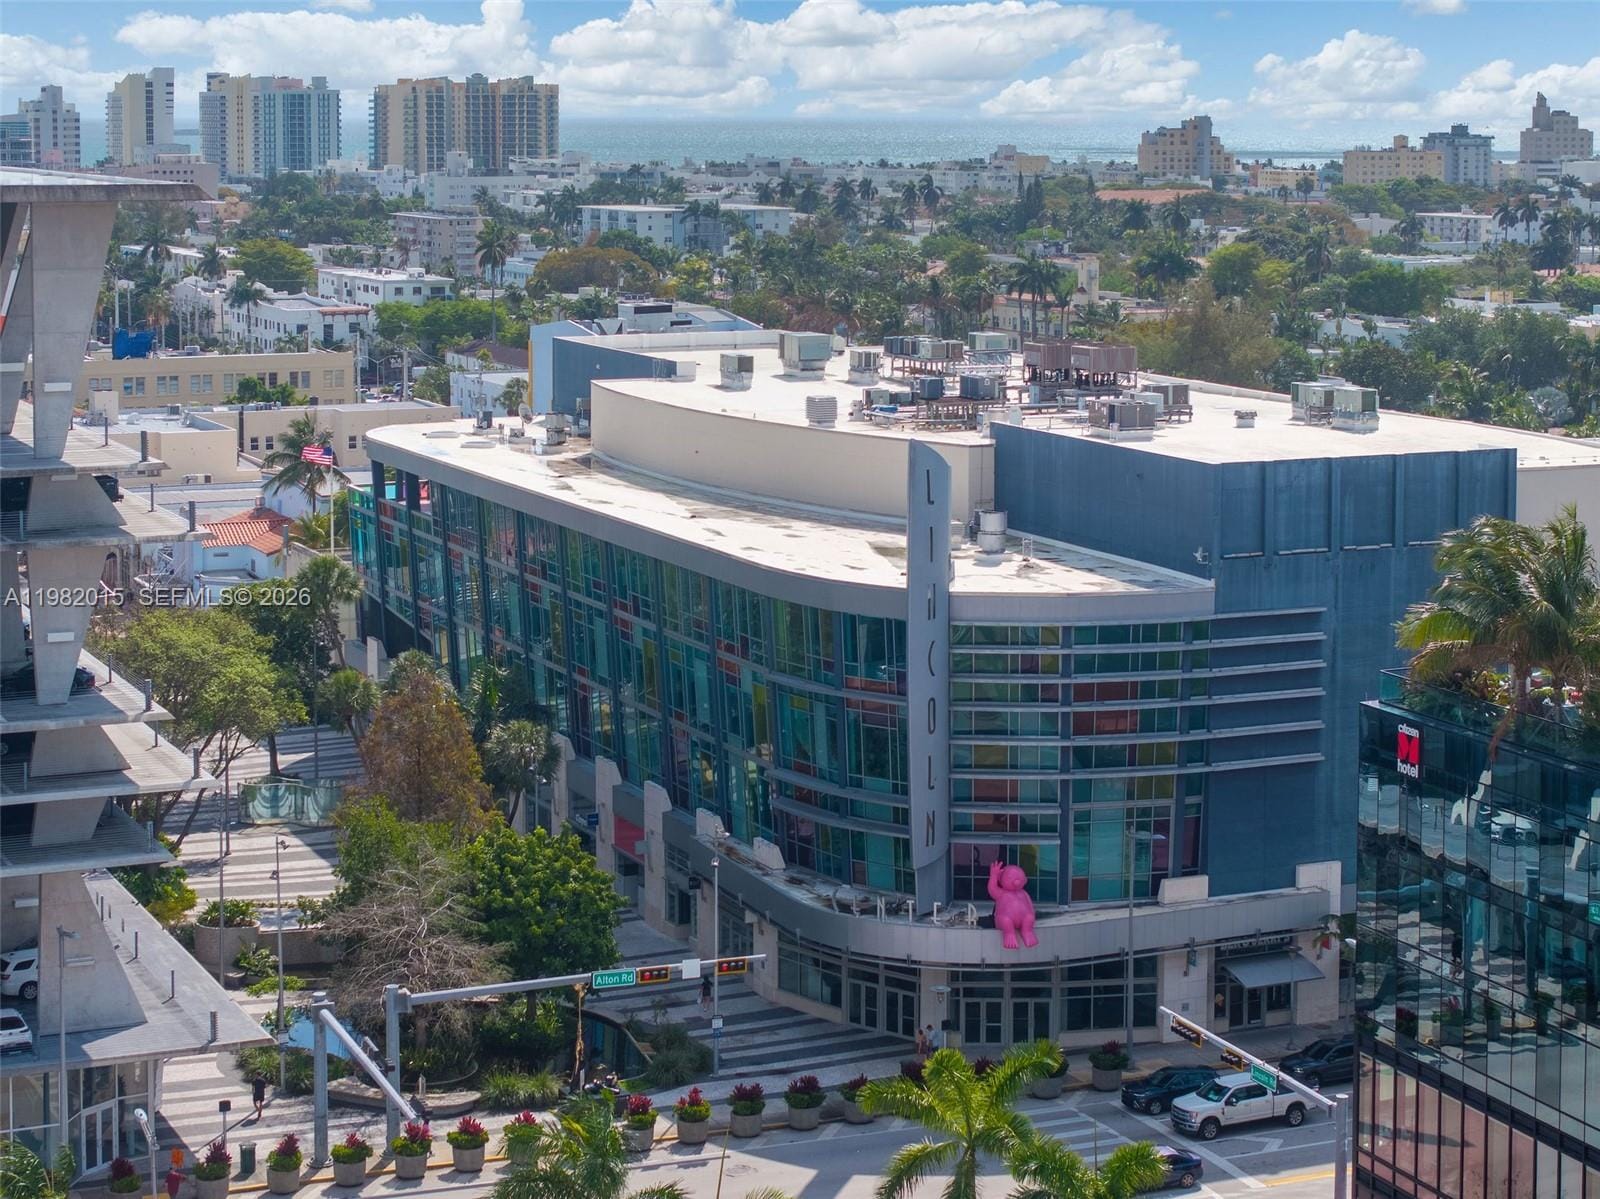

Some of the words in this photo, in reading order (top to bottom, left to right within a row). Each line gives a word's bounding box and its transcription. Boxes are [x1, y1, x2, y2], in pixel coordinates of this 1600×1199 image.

[1397, 723, 1419, 738] citizen
[1397, 758, 1419, 778] hotel
[595, 975, 620, 985] Alton
[621, 972, 634, 983] Rd
